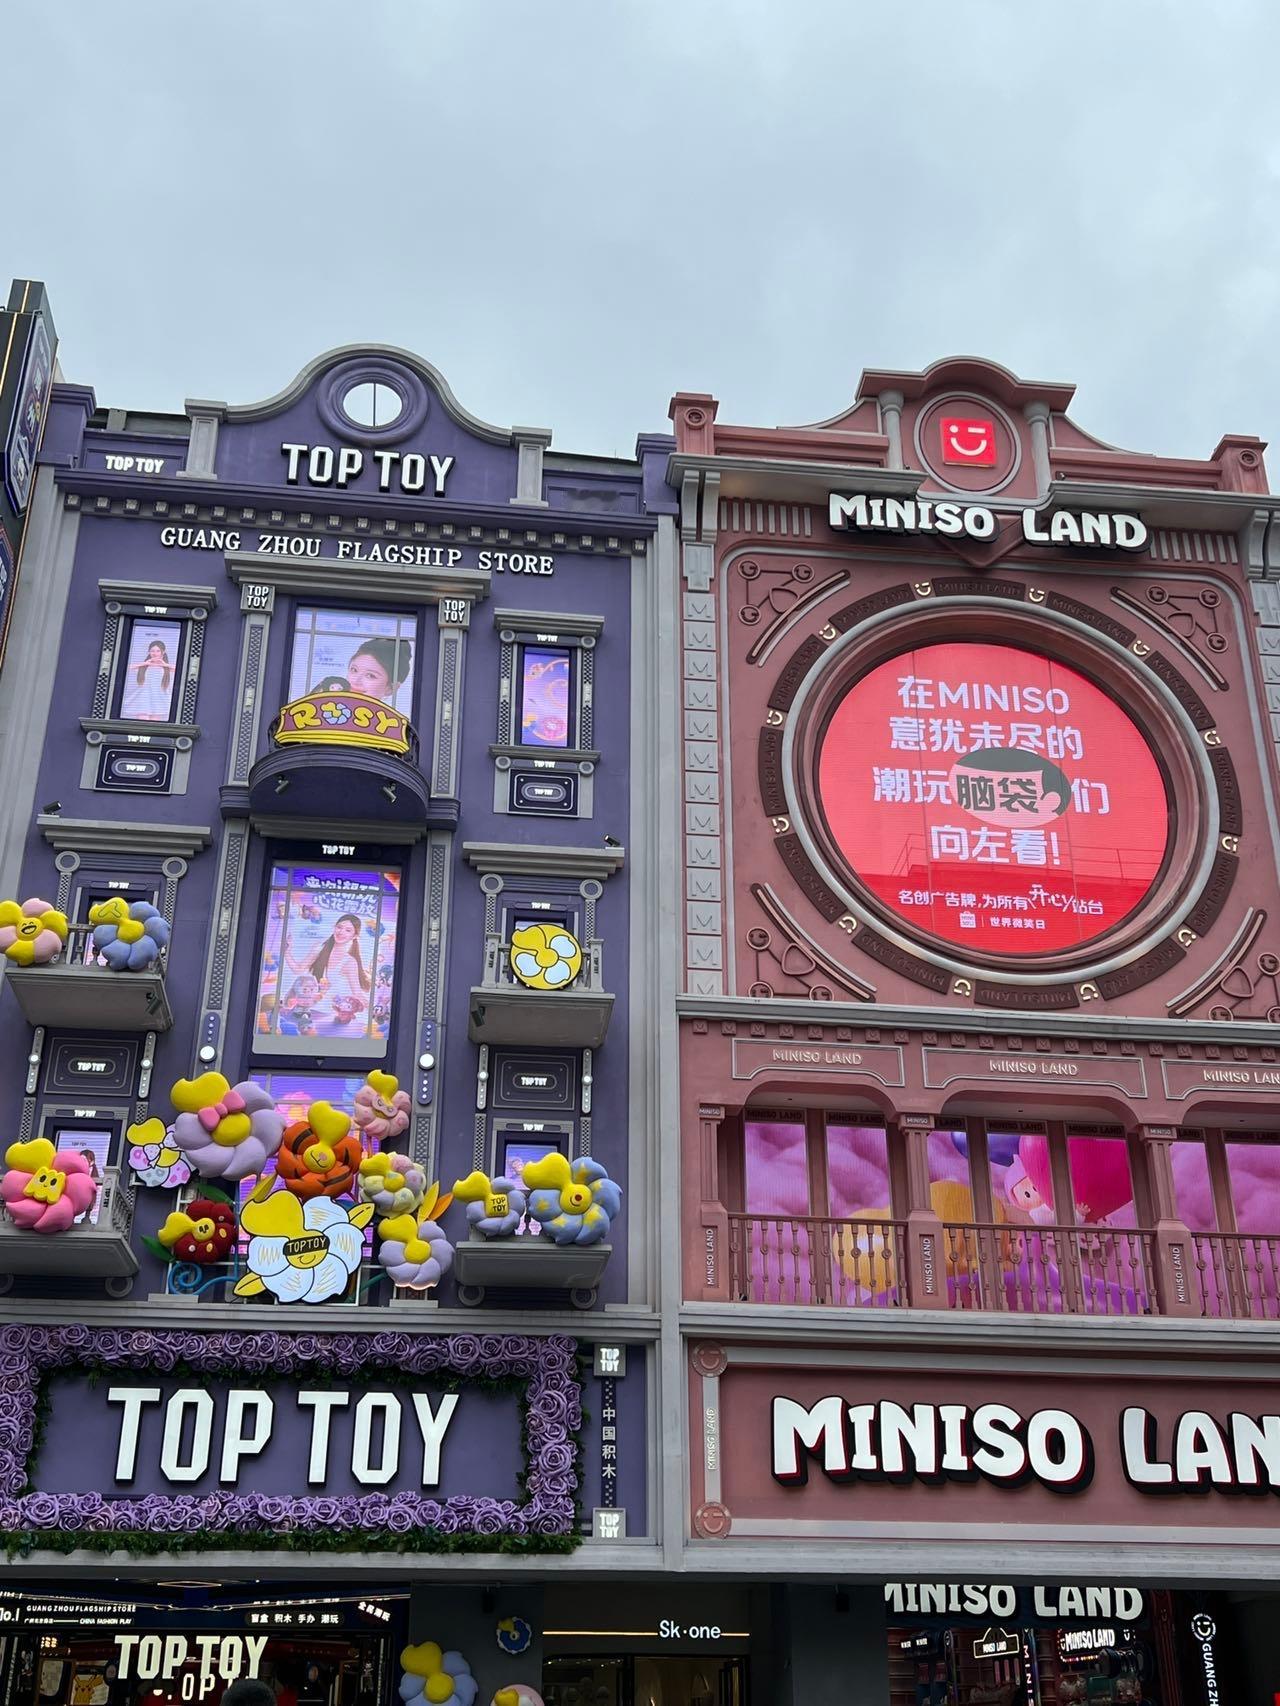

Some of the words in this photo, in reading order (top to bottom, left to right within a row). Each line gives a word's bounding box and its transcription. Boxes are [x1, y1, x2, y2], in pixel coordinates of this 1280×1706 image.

[105, 456, 134, 471] TOP
[135, 458, 164, 473] TOY
[282, 443, 363, 485] TOP
[374, 450, 454, 493] TOY
[830, 493, 994, 538] MINISO
[1022, 508, 1148, 549] LAND
[160, 527, 241, 551] GUANG
[257, 534, 321, 558] ZHOU
[337, 541, 463, 567] FLAGSHIP
[478, 551, 554, 575] STORE
[247, 596, 268, 608] TOY
[248, 586, 269, 597] TOP
[444, 610, 465, 622] TOY
[445, 600, 465, 611] TOP
[898, 675, 1070, 714] 在MINISO
[889, 717, 1084, 760] 意犹未尽的
[872, 766, 1110, 815] 潮玩脑袋们
[322, 845, 338, 855] TOP
[339, 846, 355, 856] TOY
[773, 1049, 820, 1063] MINISO
[825, 1051, 862, 1065] LAND
[990, 1060, 1037, 1074] MINISO
[1041, 1061, 1078, 1076] LAND
[1203, 1070, 1250, 1083] MINISO
[907, 1117, 928, 1125] MINISO
[1150, 1128, 1171, 1136] MINISO
[491, 1197, 506, 1205] TOP
[492, 1204, 506, 1213] TOY
[706, 1229, 714, 1252] LAND
[923, 1238, 932, 1261] LAND
[1172, 1247, 1182, 1270] LAND
[706, 1254, 714, 1285] MINISO
[925, 1263, 934, 1293] MINISO
[1175, 1272, 1186, 1302] MINISO
[600, 1348, 620, 1360] TOP
[600, 1360, 620, 1372] TOY
[706, 1408, 716, 1434] LAND
[107, 1387, 274, 1482] TOP
[298, 1391, 460, 1485] TOY
[602, 1407, 616, 1479] 中国积木
[774, 1396, 1086, 1484] MINISO
[707, 1434, 717, 1470] MINISO
[600, 1513, 620, 1526] TOP
[600, 1525, 619, 1538] TOY
[75, 1605, 111, 1613] FLAGSHIP
[113, 1605, 137, 1613] STORE
[884, 1583, 1016, 1617] MINISO
[1034, 1585, 1143, 1620] LAND
[274, 1613, 292, 1624] 积木
[298, 1613, 316, 1624] 手办
[321, 1614, 339, 1624] 潮玩
[1092, 1629, 1115, 1648] LAND
[114, 1635, 188, 1679] TOP
[196, 1636, 268, 1679] TOY
[1202, 1643, 1217, 1688] GUANG
